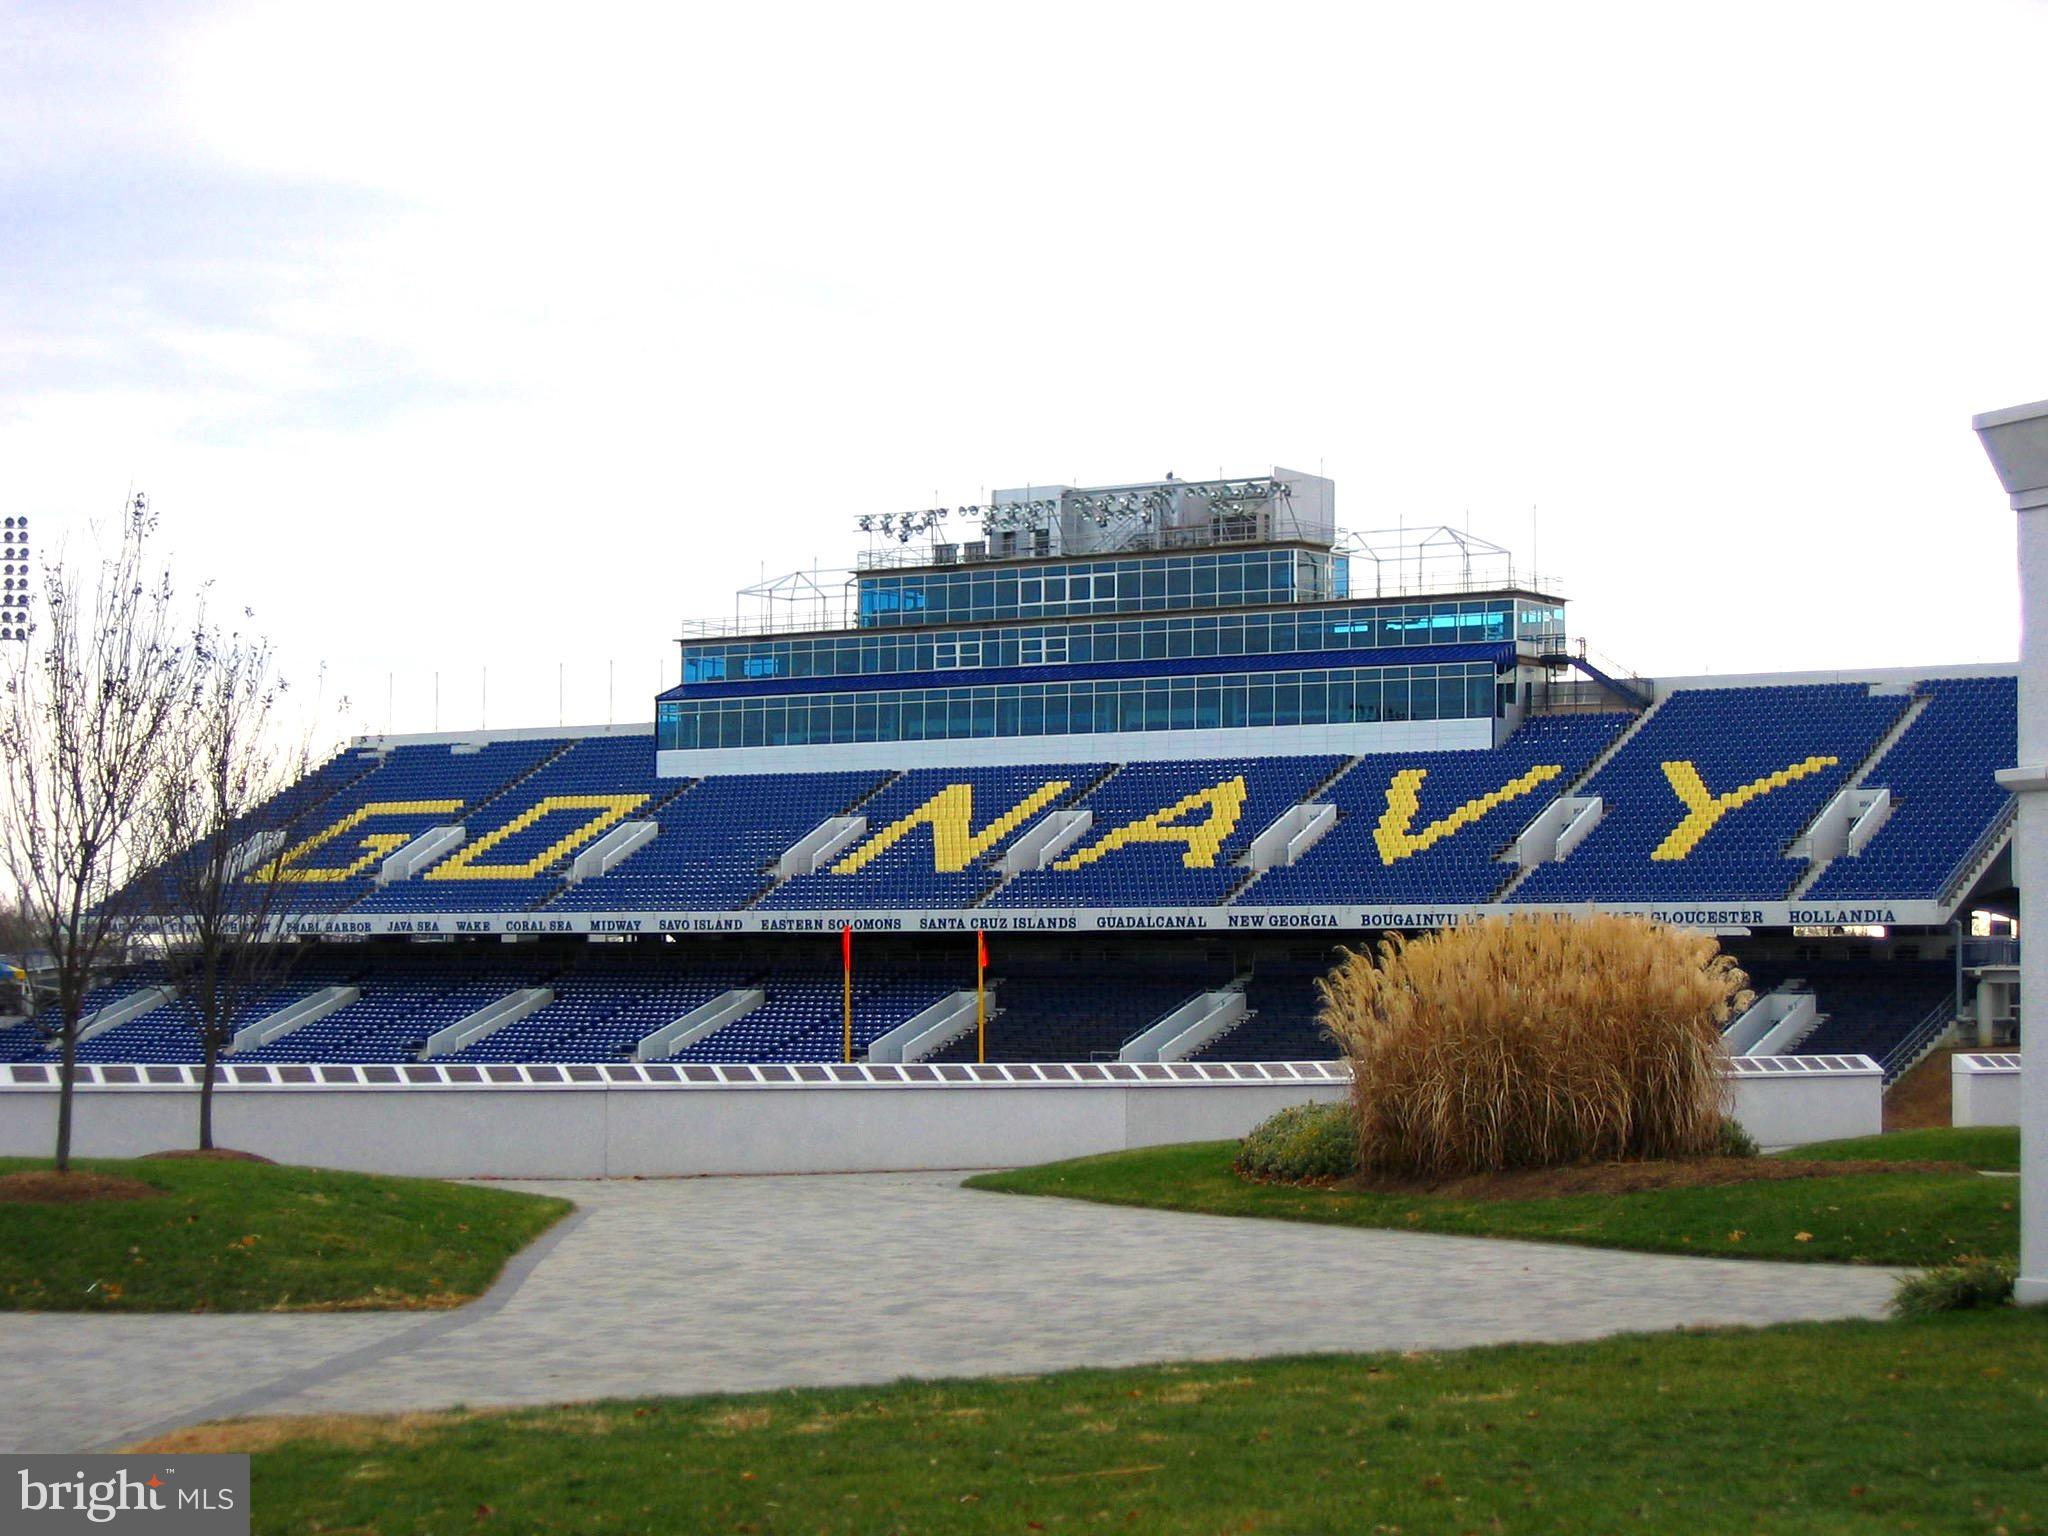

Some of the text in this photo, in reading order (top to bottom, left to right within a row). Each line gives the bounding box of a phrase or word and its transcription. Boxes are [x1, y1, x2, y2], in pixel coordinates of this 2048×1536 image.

[244, 756, 1838, 883] GO NAVY
[1096, 916, 1207, 928] GUADALCANAL
[1228, 915, 1338, 927] NEW GEORGIA
[1651, 911, 1763, 924] GLOUCESTER
[1789, 910, 1896, 923] HOLLANDIA
[286, 922, 372, 933] PEARL HARBOR
[387, 921, 440, 932] JAVA SEA
[456, 921, 491, 931] WAKE
[506, 920, 573, 931] CORAL SEA
[590, 920, 642, 931] MIDWAY
[659, 919, 743, 931] SAVO ISLAND
[761, 918, 902, 930] EASTERN SOLOMONS
[919, 917, 1077, 929] SANTA CRUZ ISLANDS
